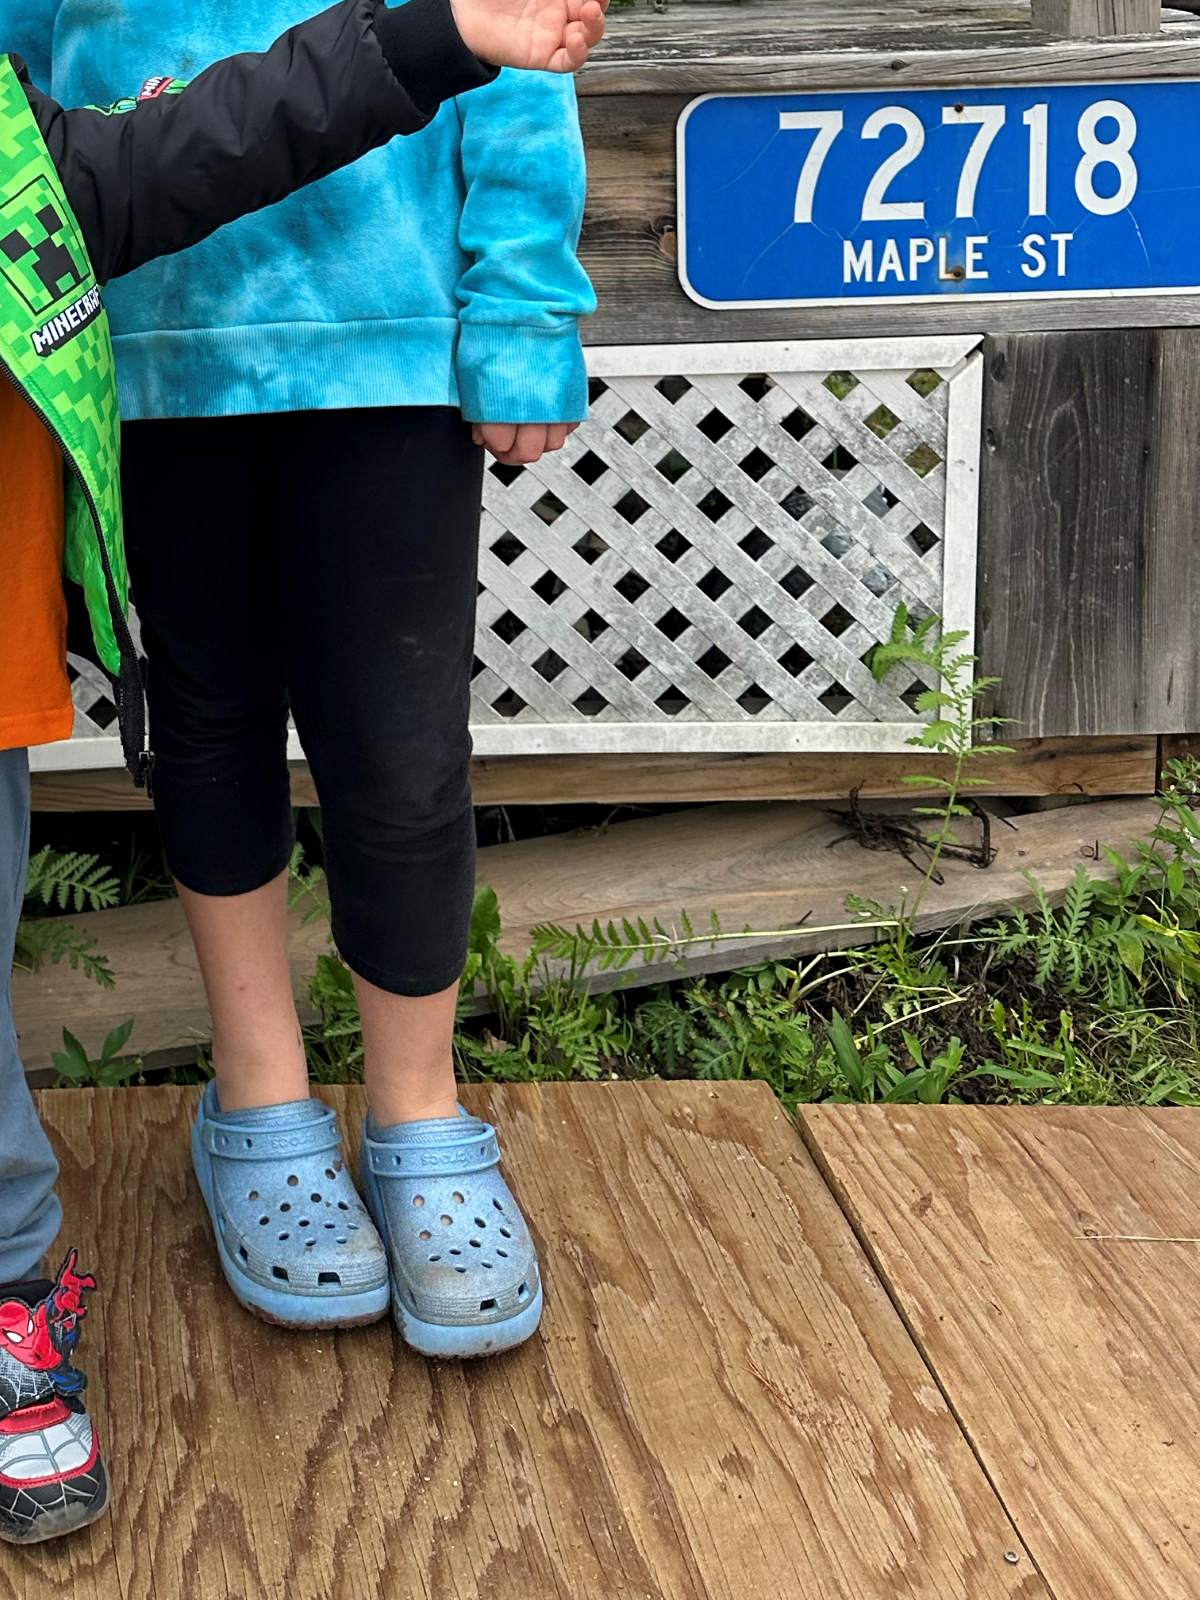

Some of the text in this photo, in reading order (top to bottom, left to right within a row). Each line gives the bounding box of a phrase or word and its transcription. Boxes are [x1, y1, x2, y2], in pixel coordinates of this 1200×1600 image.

[779, 99, 1139, 224] 72718
[843, 233, 1075, 283] MAPLE ST
